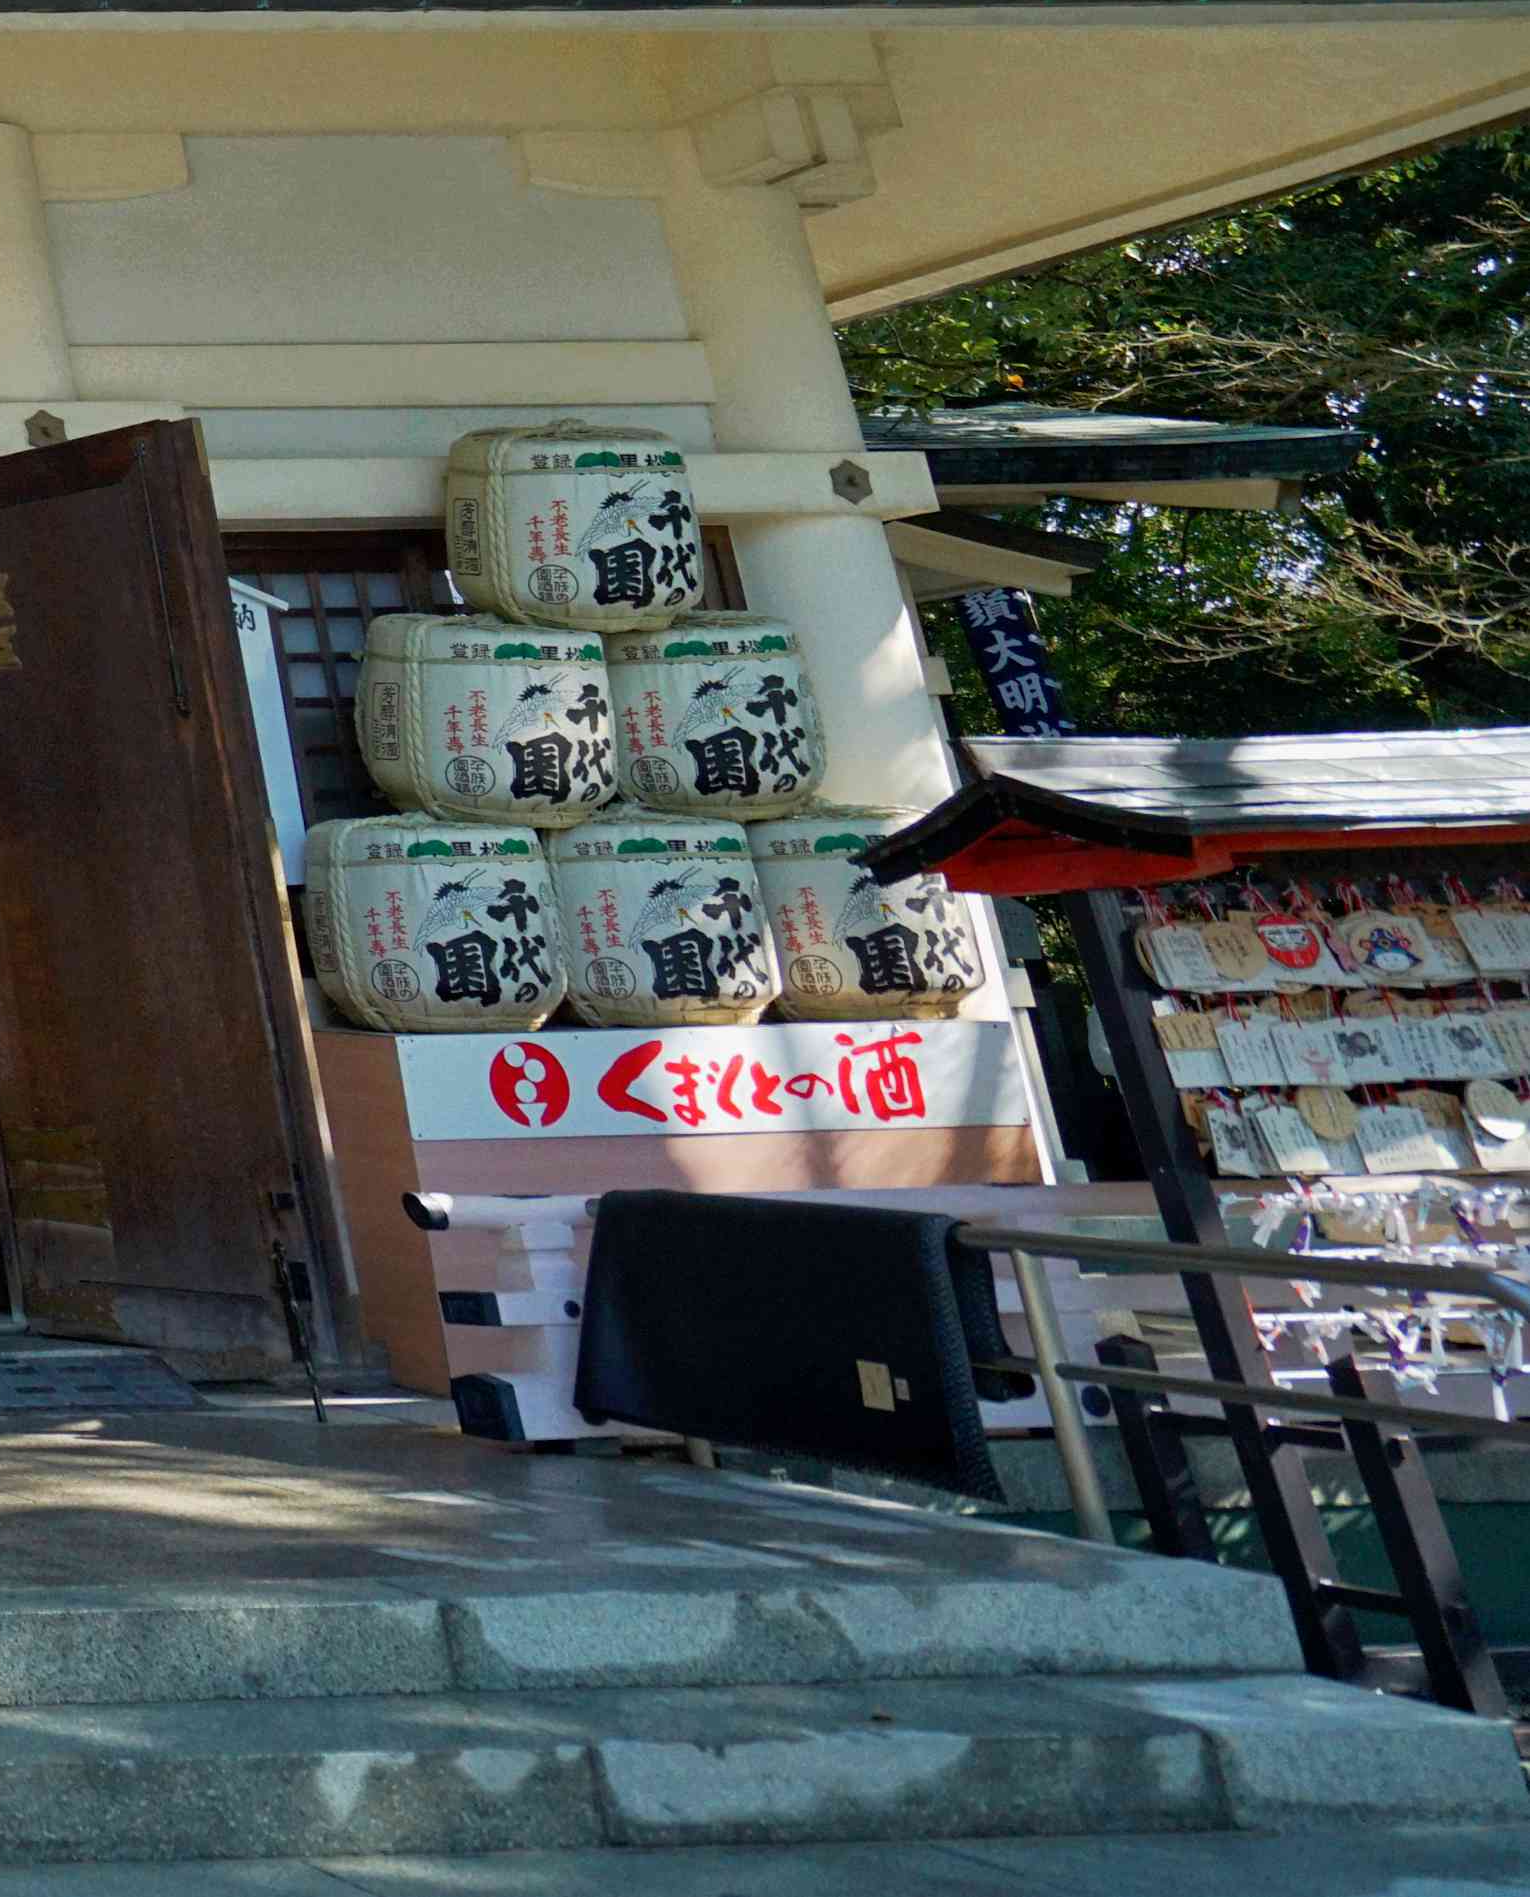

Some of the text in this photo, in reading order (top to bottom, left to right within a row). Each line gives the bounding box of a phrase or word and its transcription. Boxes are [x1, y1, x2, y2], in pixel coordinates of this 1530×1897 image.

[598, 1031, 926, 1127] くまもとの酒
